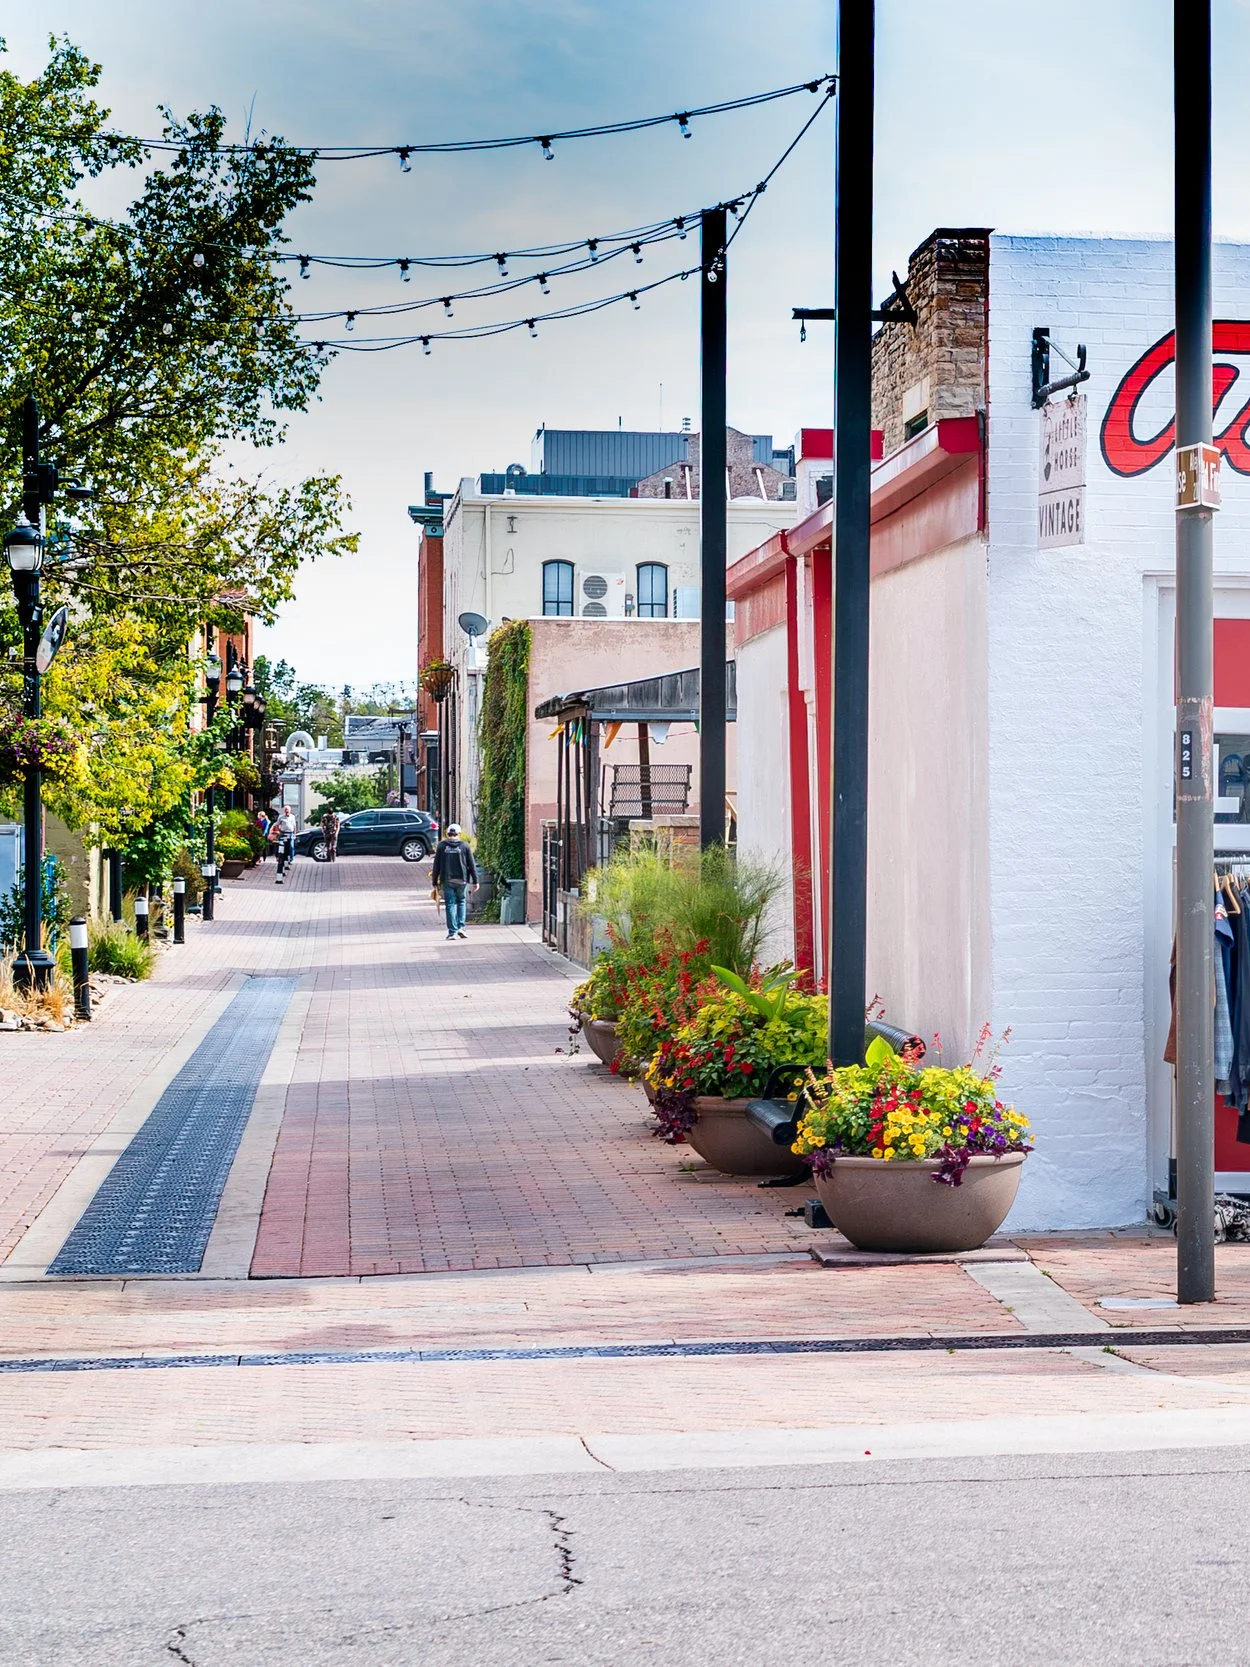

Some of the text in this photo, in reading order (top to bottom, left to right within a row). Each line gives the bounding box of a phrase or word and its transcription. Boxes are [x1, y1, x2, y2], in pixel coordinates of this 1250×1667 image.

[1053, 416, 1078, 443] LITTLE
[1053, 447, 1078, 472] HORSE
[1038, 498, 1081, 538] VINTAGE
